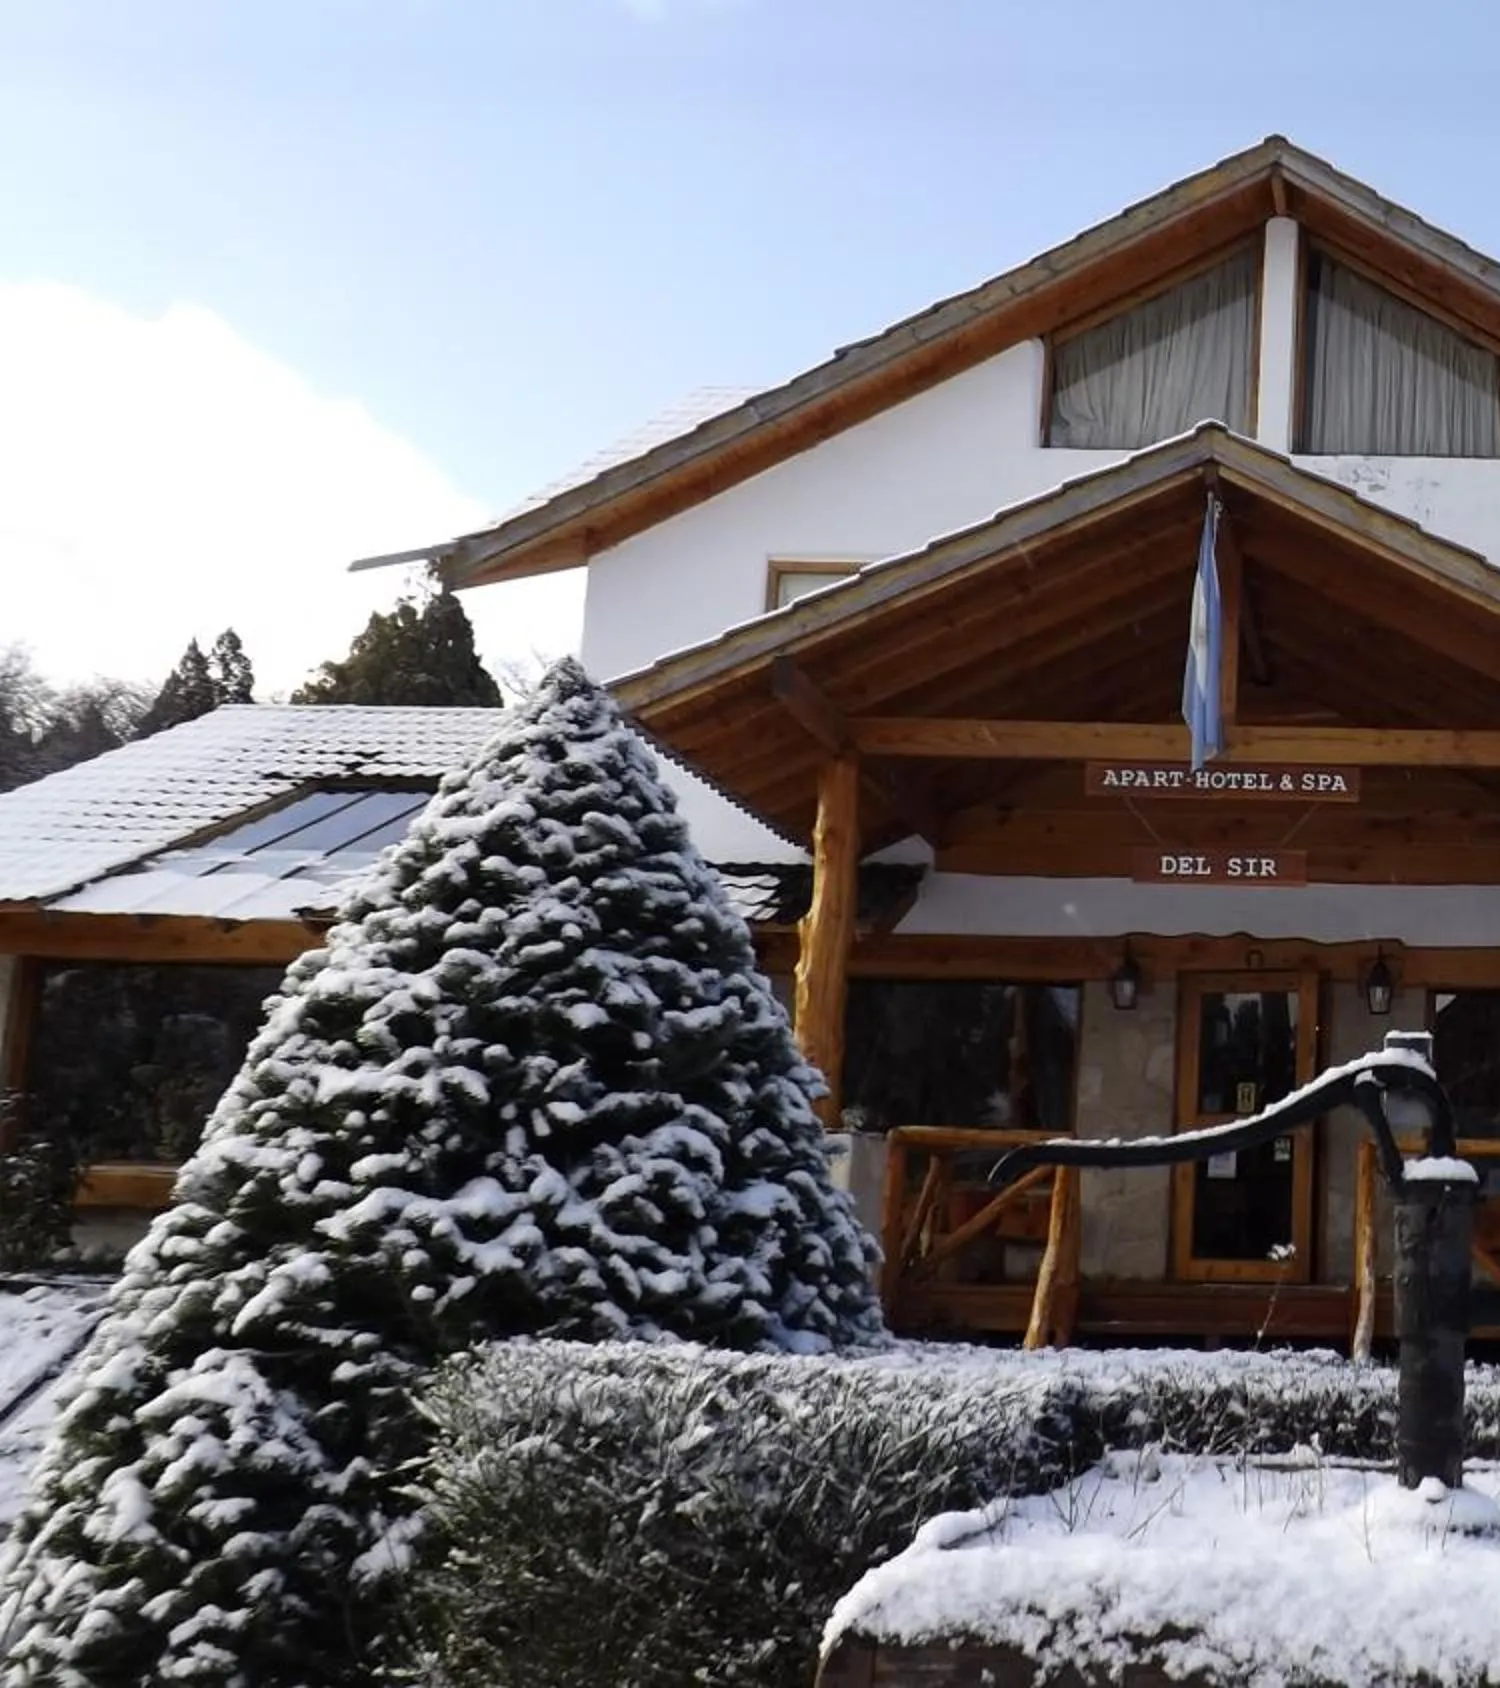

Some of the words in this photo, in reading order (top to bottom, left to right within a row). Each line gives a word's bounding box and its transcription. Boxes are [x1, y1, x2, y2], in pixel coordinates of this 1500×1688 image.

[1279, 774, 1294, 791] &
[1301, 773, 1348, 791] SPA
[1161, 856, 1211, 875] DEL
[1227, 858, 1277, 876] SIR
